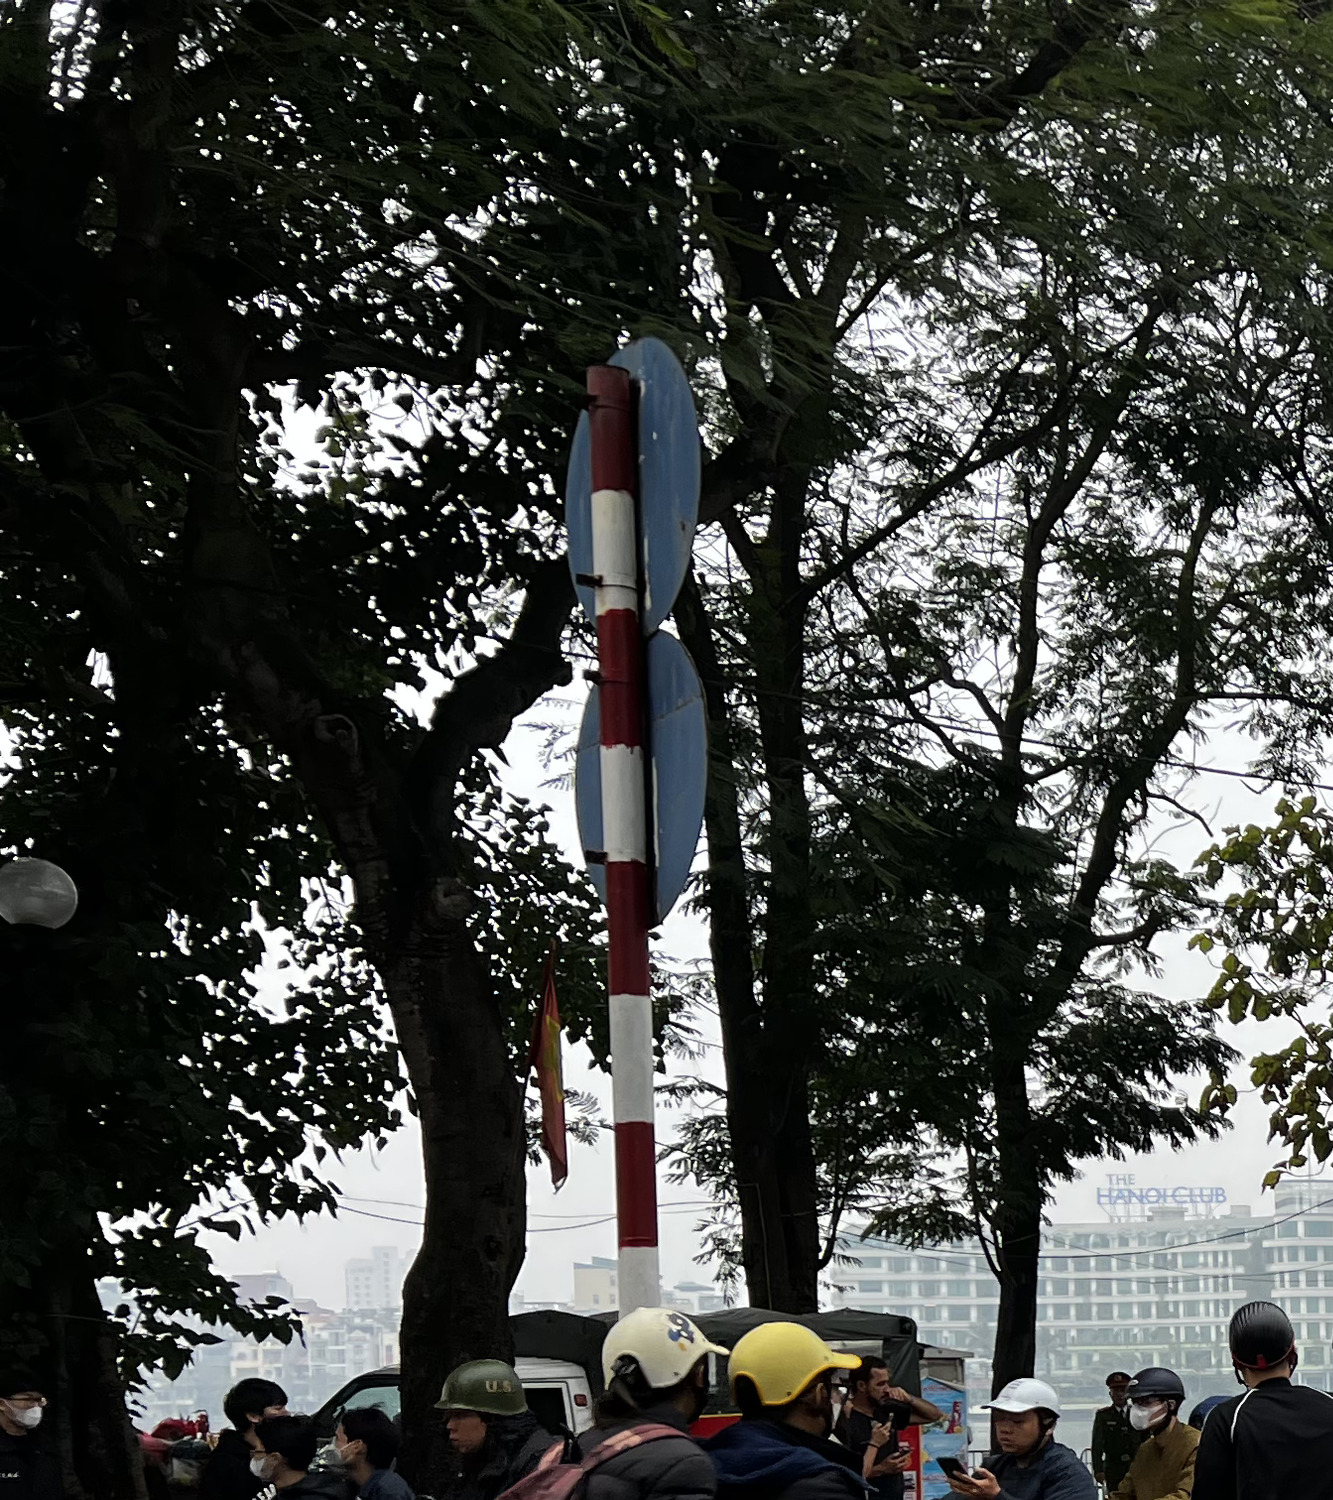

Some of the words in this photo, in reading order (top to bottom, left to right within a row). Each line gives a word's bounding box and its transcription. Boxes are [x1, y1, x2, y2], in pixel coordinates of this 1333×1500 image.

[1106, 1174, 1136, 1186] THE
[1096, 1187, 1167, 1205] HANOI
[1172, 1186, 1227, 1204] CLUB
